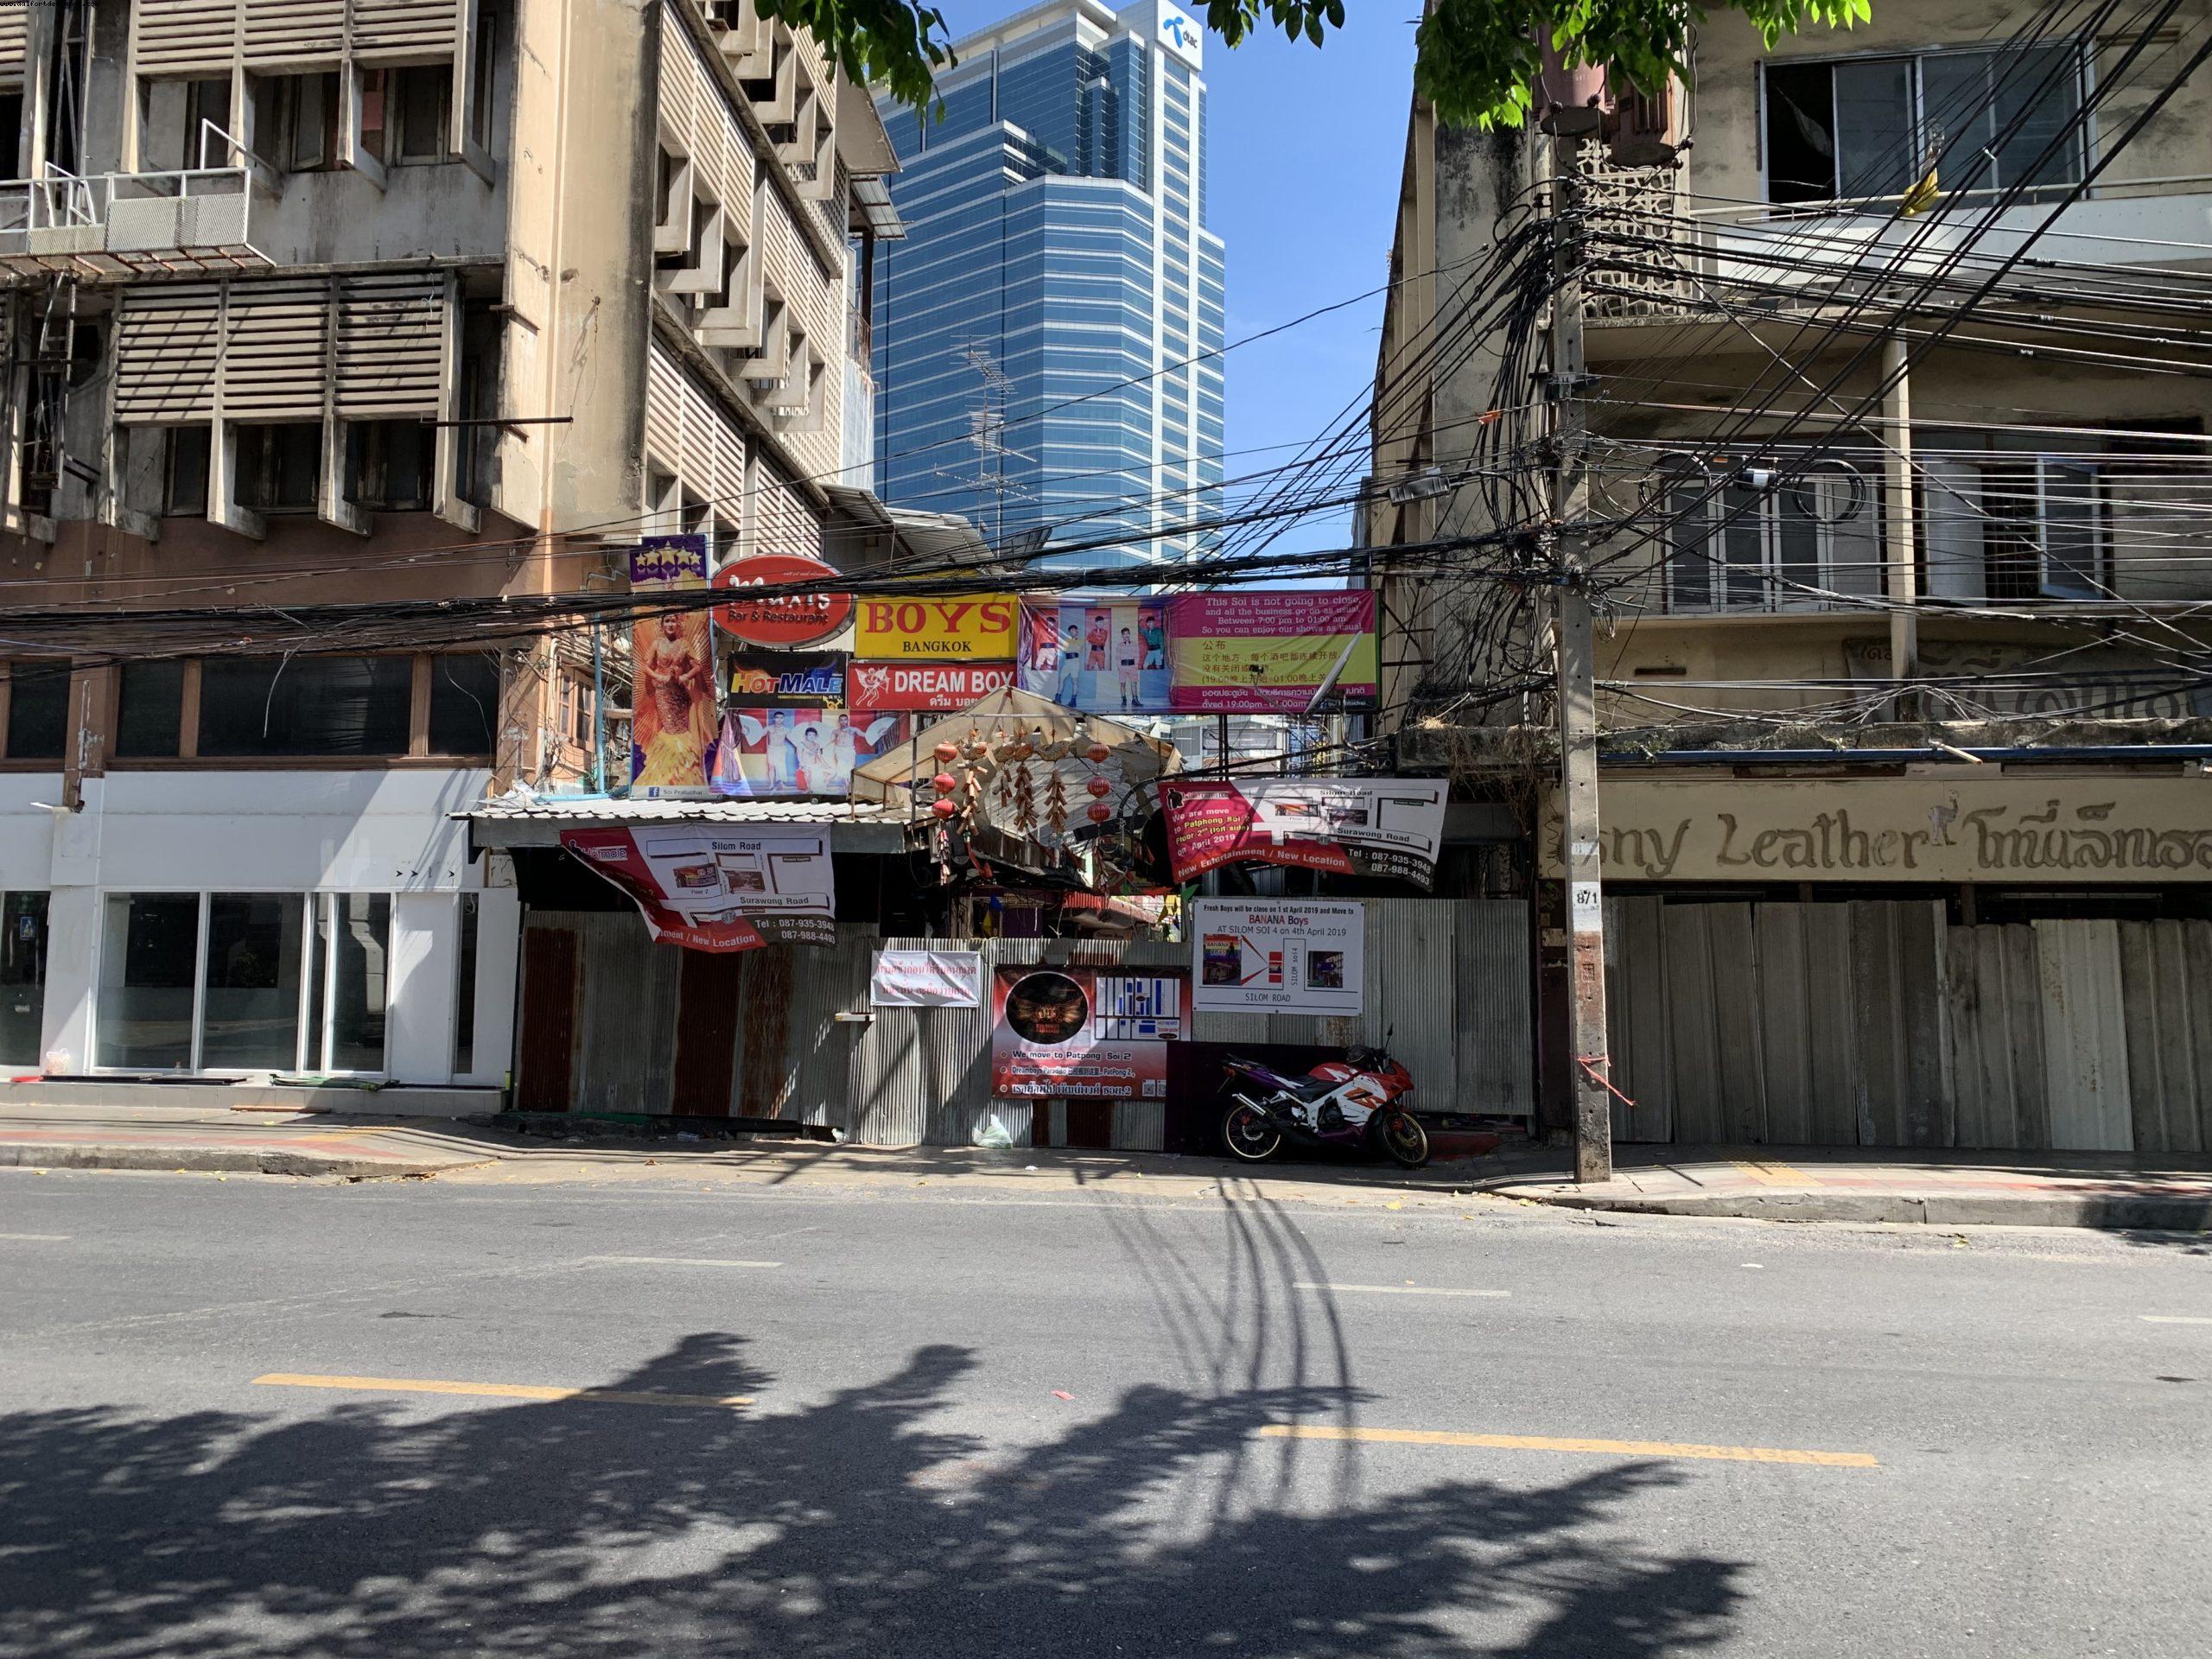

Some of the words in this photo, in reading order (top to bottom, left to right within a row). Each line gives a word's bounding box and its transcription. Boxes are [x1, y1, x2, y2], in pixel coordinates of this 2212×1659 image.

[1205, 597, 1228, 607] This
[1231, 597, 1246, 606] Soi
[1251, 597, 1259, 606] is
[1264, 597, 1280, 606] not
[1285, 597, 1313, 607] going
[728, 609, 747, 623] Bar
[752, 610, 760, 623] &
[763, 610, 830, 626] Restaurant
[865, 602, 1011, 634] BOYS
[1217, 616, 1258, 625] Between
[1278, 617, 1293, 626] pm
[1253, 626, 1274, 635] enjoy
[903, 641, 971, 652] BANGKOK
[894, 671, 965, 693] DREAM
[972, 671, 1014, 693] BOY
[929, 693, 950, 707] ดรีม
[1172, 813, 1186, 823] We
[1184, 817, 1224, 829] Patphong
[1175, 832, 1195, 845] Floor
[1338, 827, 1382, 839] Surawong
[1386, 833, 1410, 842] Road
[1716, 808, 1927, 870] Leather
[711, 842, 736, 850] Silom
[739, 842, 761, 850] Road
[1177, 848, 1186, 856] on
[1192, 839, 1211, 851] April
[1213, 835, 1236, 843] 2019
[1178, 864, 1198, 878] New
[1200, 849, 1266, 868] Entertainment
[1277, 850, 1299, 861] New
[1302, 855, 1345, 868] Location
[1348, 848, 1362, 858] Tel
[1371, 852, 1432, 874] 087-935-3948
[1370, 863, 1430, 886] 087-988-4493
[740, 897, 783, 906] Surawong
[754, 918, 770, 929] Tel
[779, 918, 835, 931] 087-935-3948
[1249, 914, 1285, 925] BANANA
[1288, 916, 1308, 926] Boys
[781, 930, 836, 944] 087-988-4493
[1229, 925, 1254, 934] SILOM
[1306, 927, 1325, 937] April
[1327, 928, 1346, 937] 2019
[693, 934, 710, 946] New
[713, 933, 756, 948] Location
[1245, 993, 1268, 1001] SILOM
[1272, 994, 1291, 1002] ROAD
[1066, 1051, 1101, 1061] Patpong
[1107, 1052, 1121, 1060] Soi
